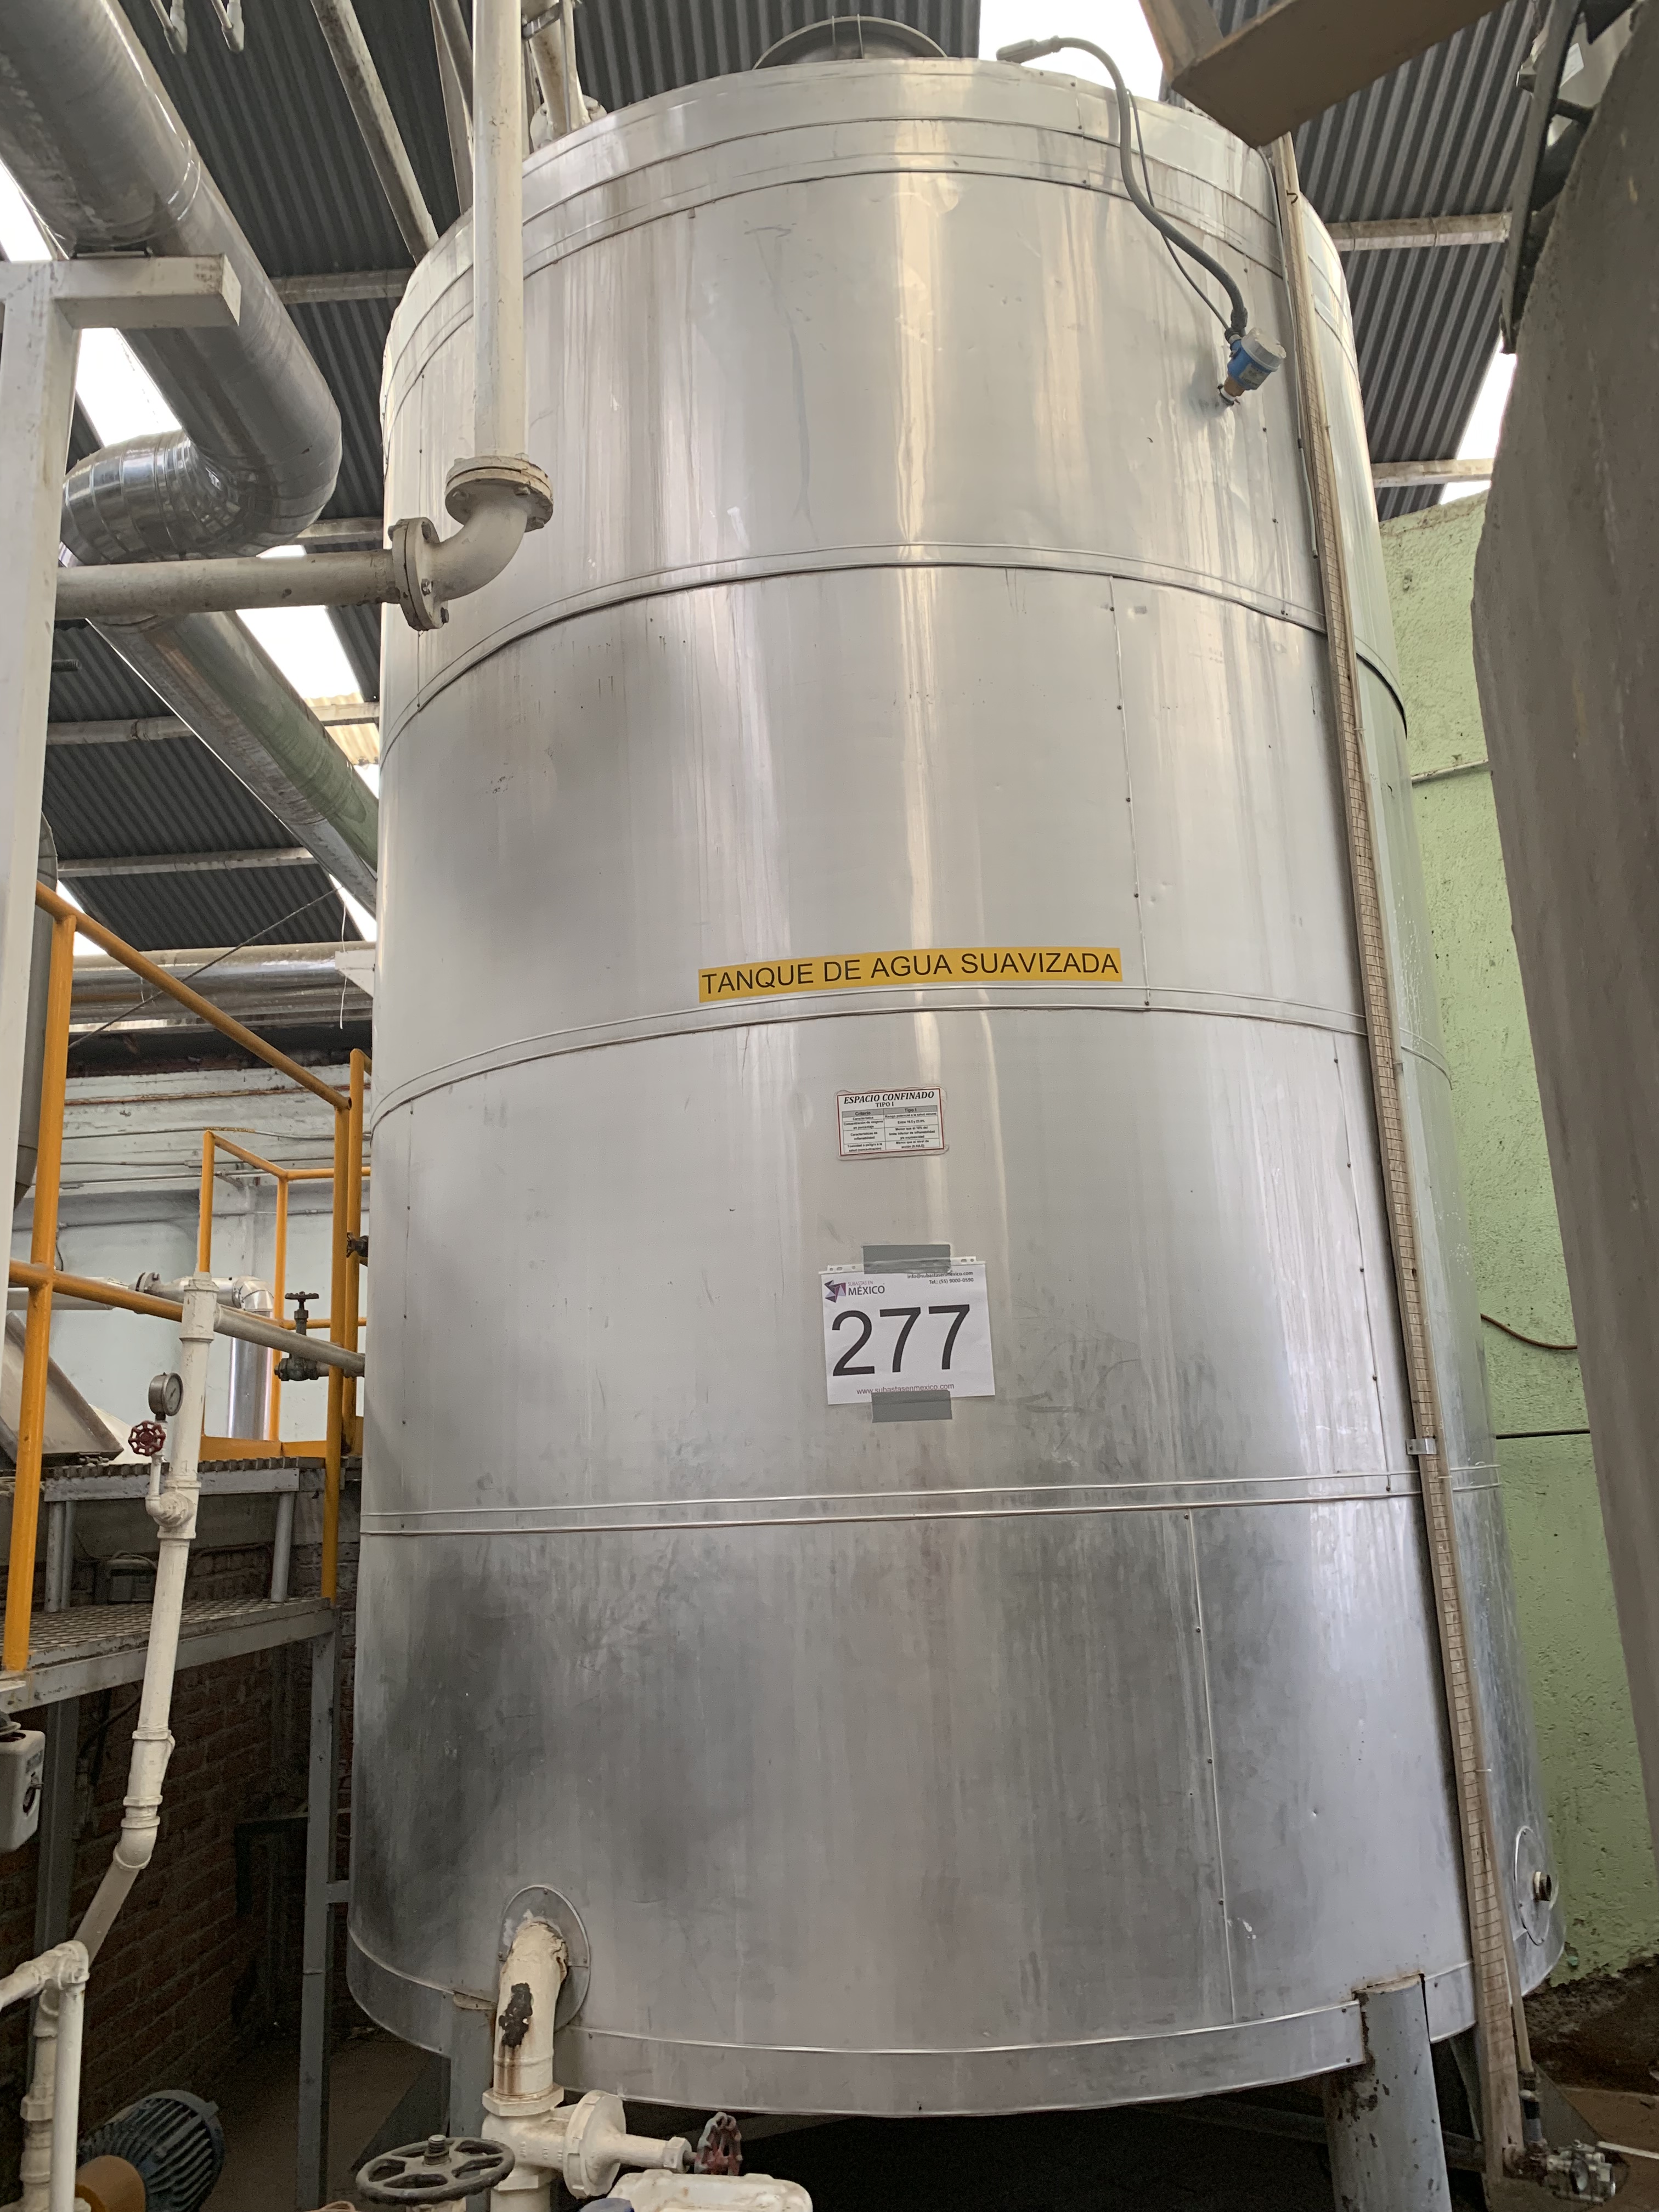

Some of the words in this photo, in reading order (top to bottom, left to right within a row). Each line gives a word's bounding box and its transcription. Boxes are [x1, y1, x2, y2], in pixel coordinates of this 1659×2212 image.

[702, 963, 814, 994] TANQUE
[824, 960, 861, 982] DE
[871, 954, 952, 979] AGUA
[961, 952, 1119, 974] SUAVIZADA
[844, 1094, 880, 1104] ESPACIO
[882, 1091, 934, 1101] CONFINADO
[848, 1285, 885, 1295] MÉXICO
[832, 1304, 970, 1376] 277
[856, 1384, 955, 1395] wwwsubastasenmexico.com
